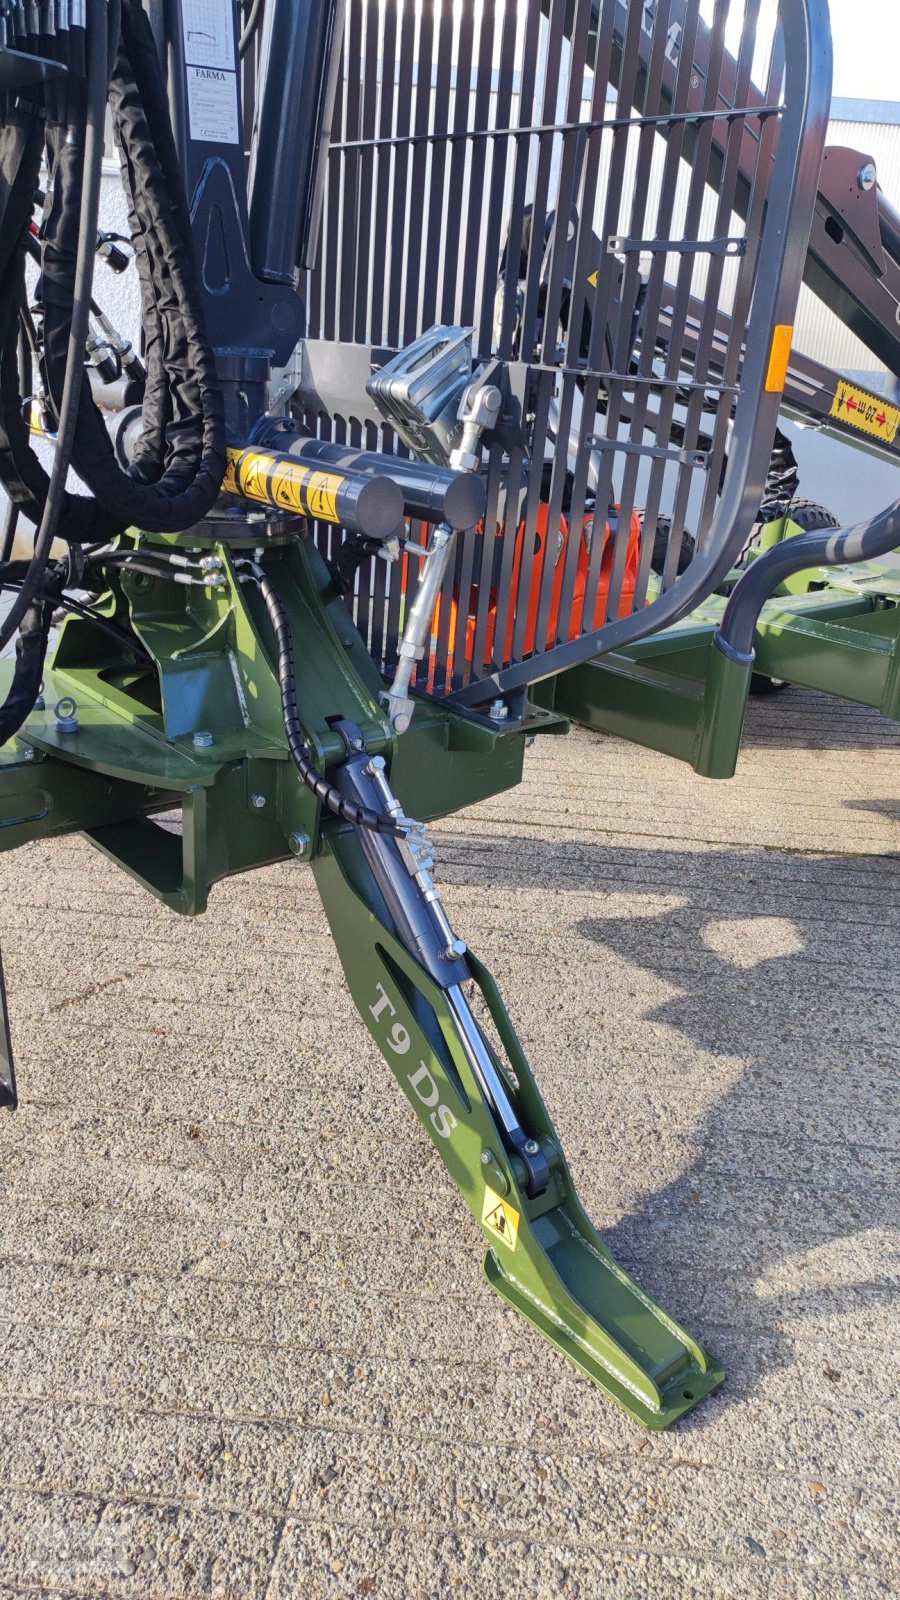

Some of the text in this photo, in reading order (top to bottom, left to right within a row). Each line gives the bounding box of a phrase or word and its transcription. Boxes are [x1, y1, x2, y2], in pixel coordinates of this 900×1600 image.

[195, 69, 226, 81] FARMA
[857, 400, 878, 423] 20 m
[369, 982, 458, 1139] T9 DS
